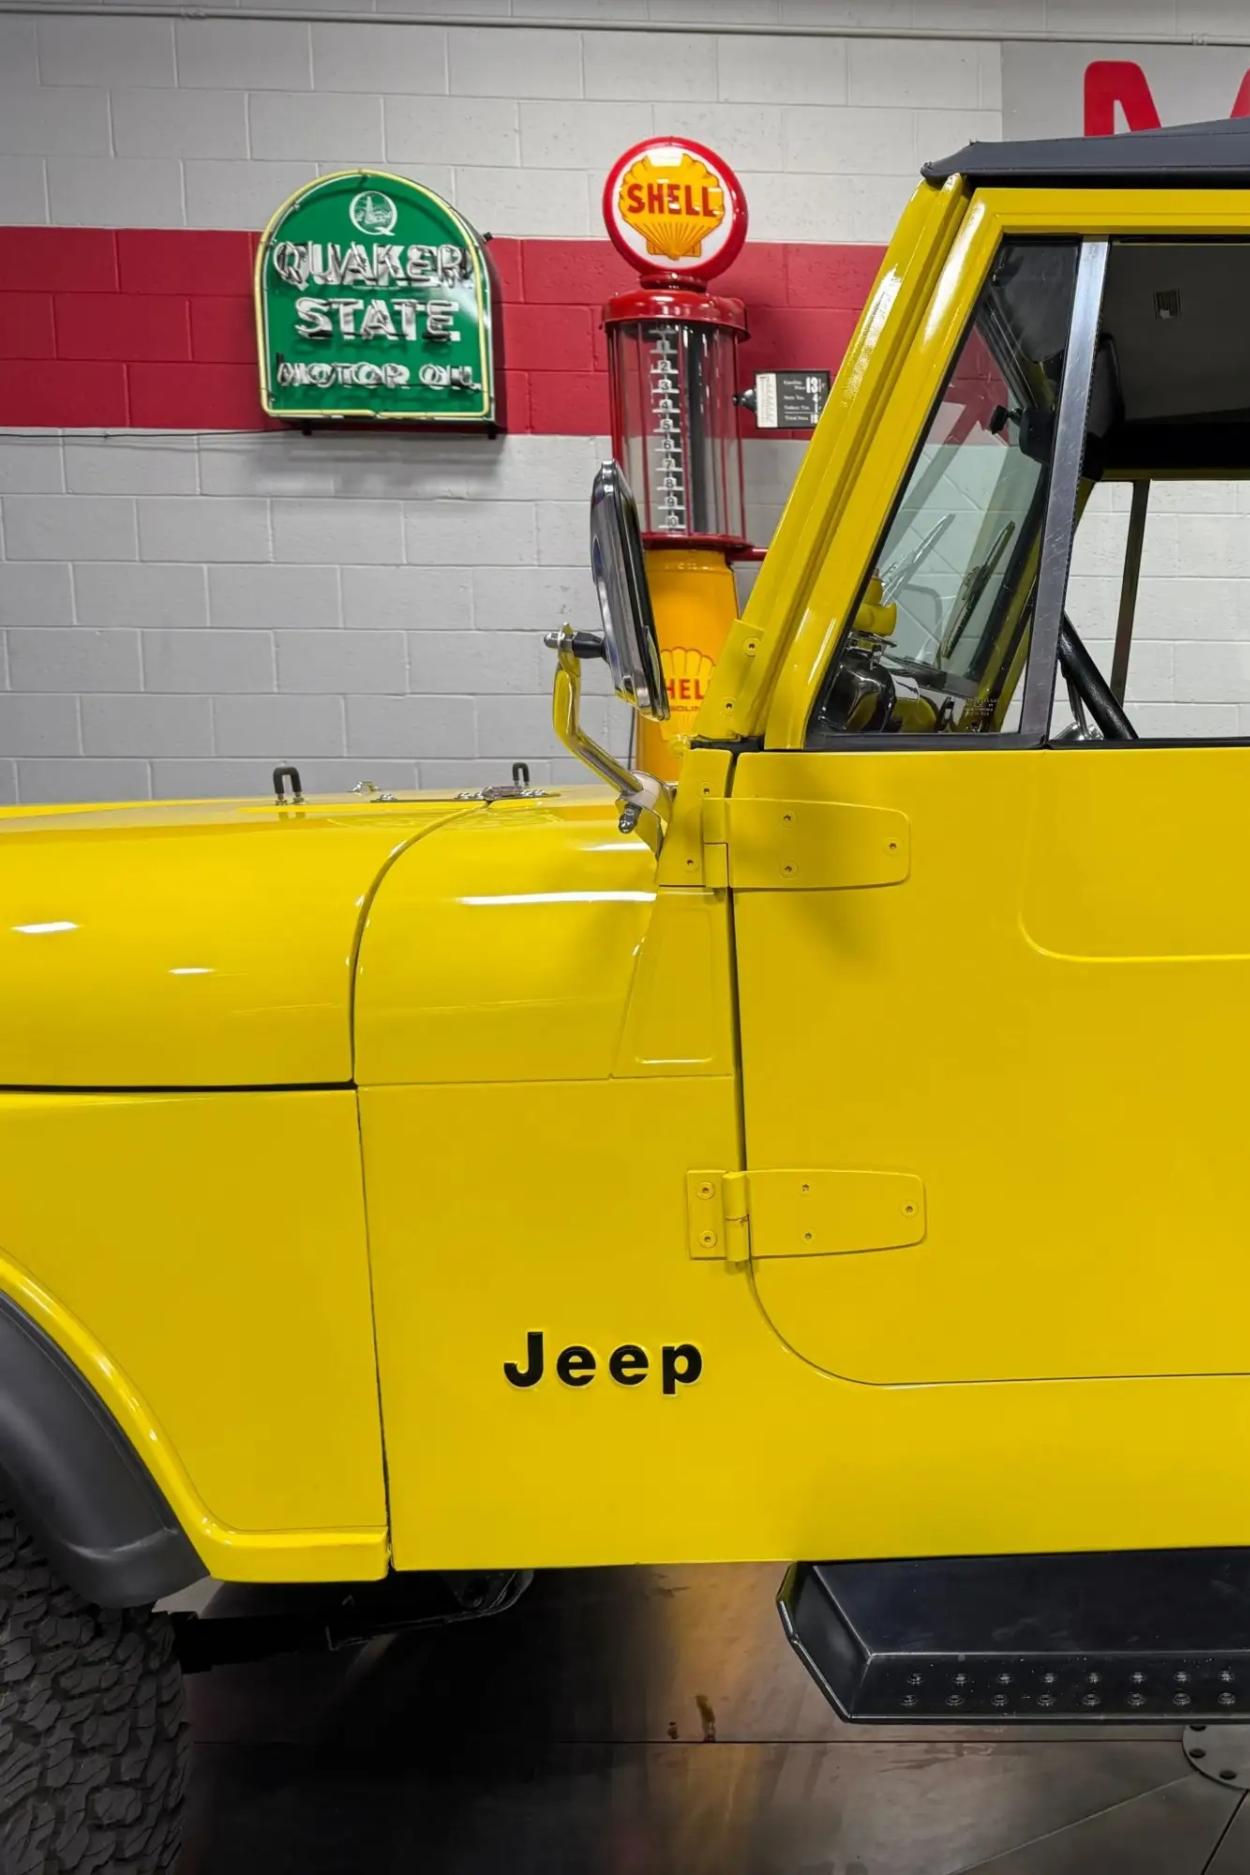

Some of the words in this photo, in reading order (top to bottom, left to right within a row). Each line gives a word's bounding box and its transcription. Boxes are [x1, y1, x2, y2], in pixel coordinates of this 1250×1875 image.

[626, 182, 719, 218] SHELL
[272, 241, 475, 291] QUAKER
[294, 296, 462, 341] STATE
[276, 361, 411, 389] MOTOR
[667, 678, 704, 700] HEL
[503, 1331, 703, 1395] Jeep
